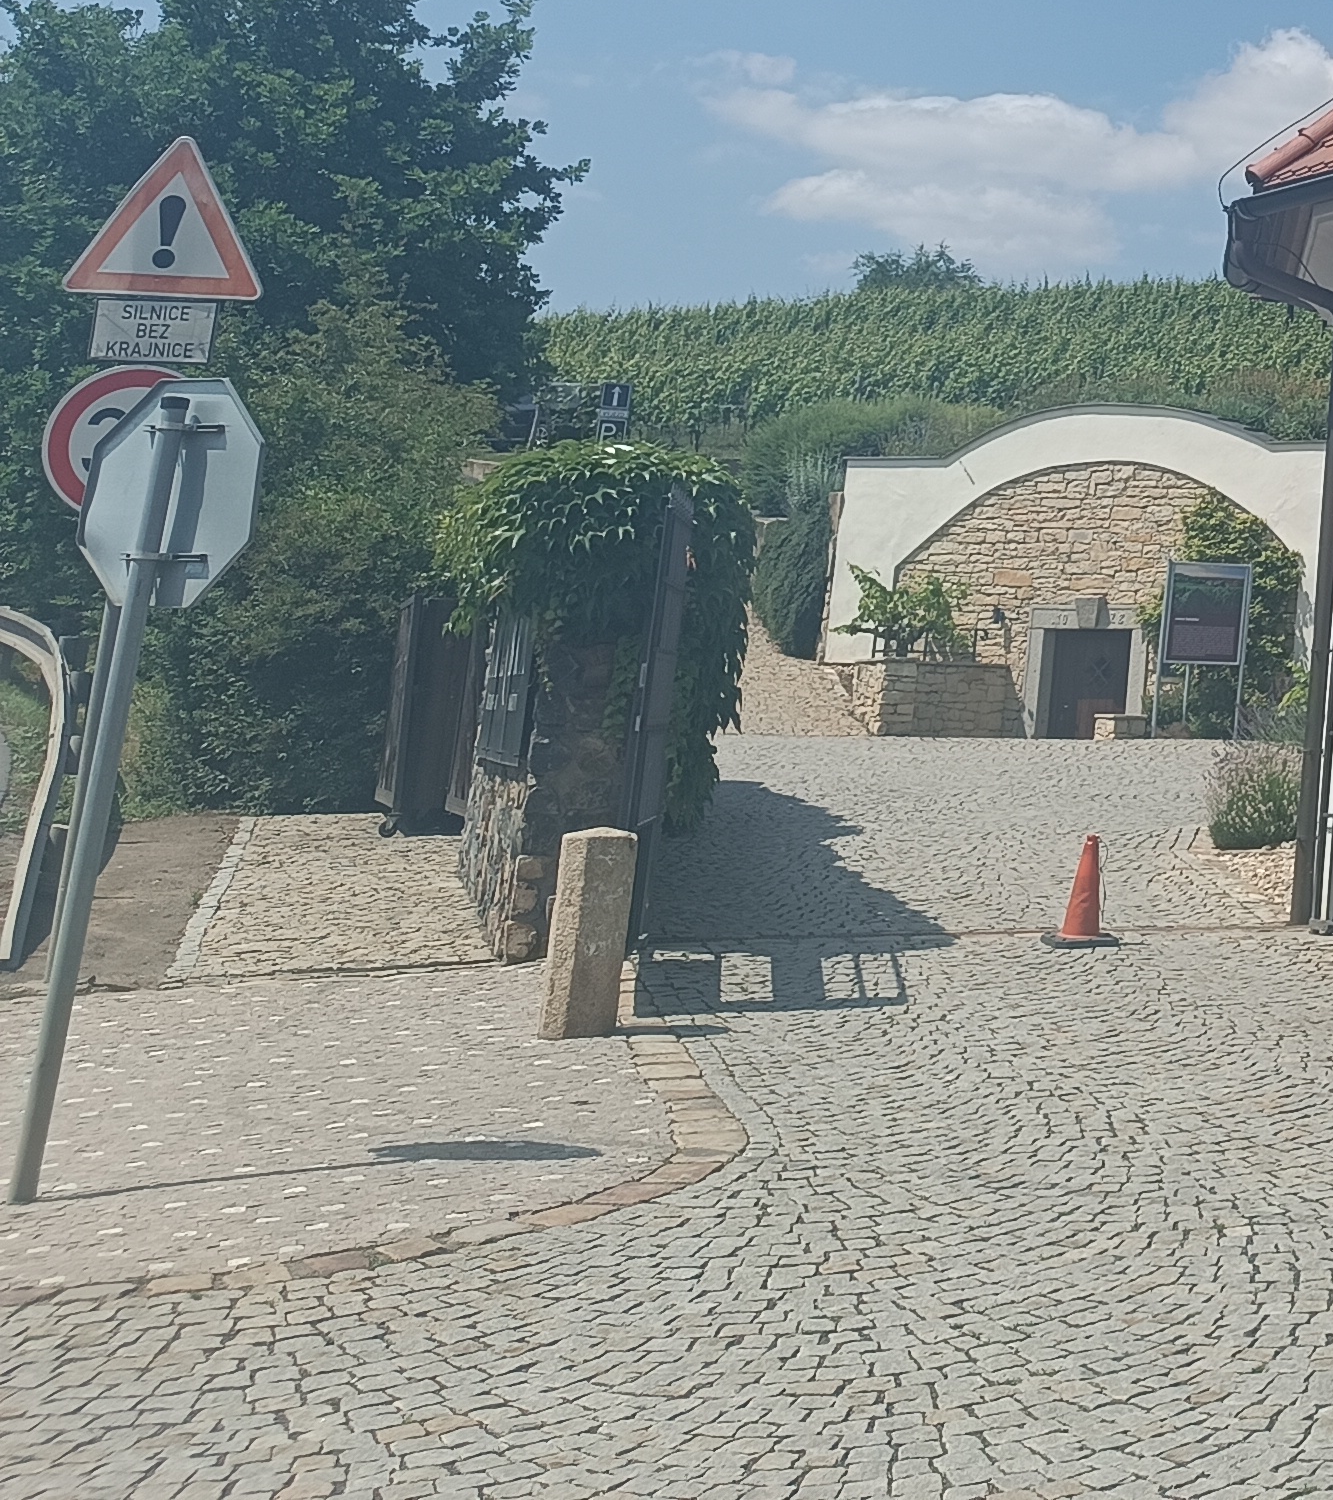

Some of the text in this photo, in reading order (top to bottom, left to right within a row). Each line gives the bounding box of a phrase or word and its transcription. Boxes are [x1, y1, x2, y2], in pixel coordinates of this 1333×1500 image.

[121, 304, 192, 321] SILNICE
[135, 323, 171, 339] BEZ
[105, 341, 195, 358] KRAJNICE
